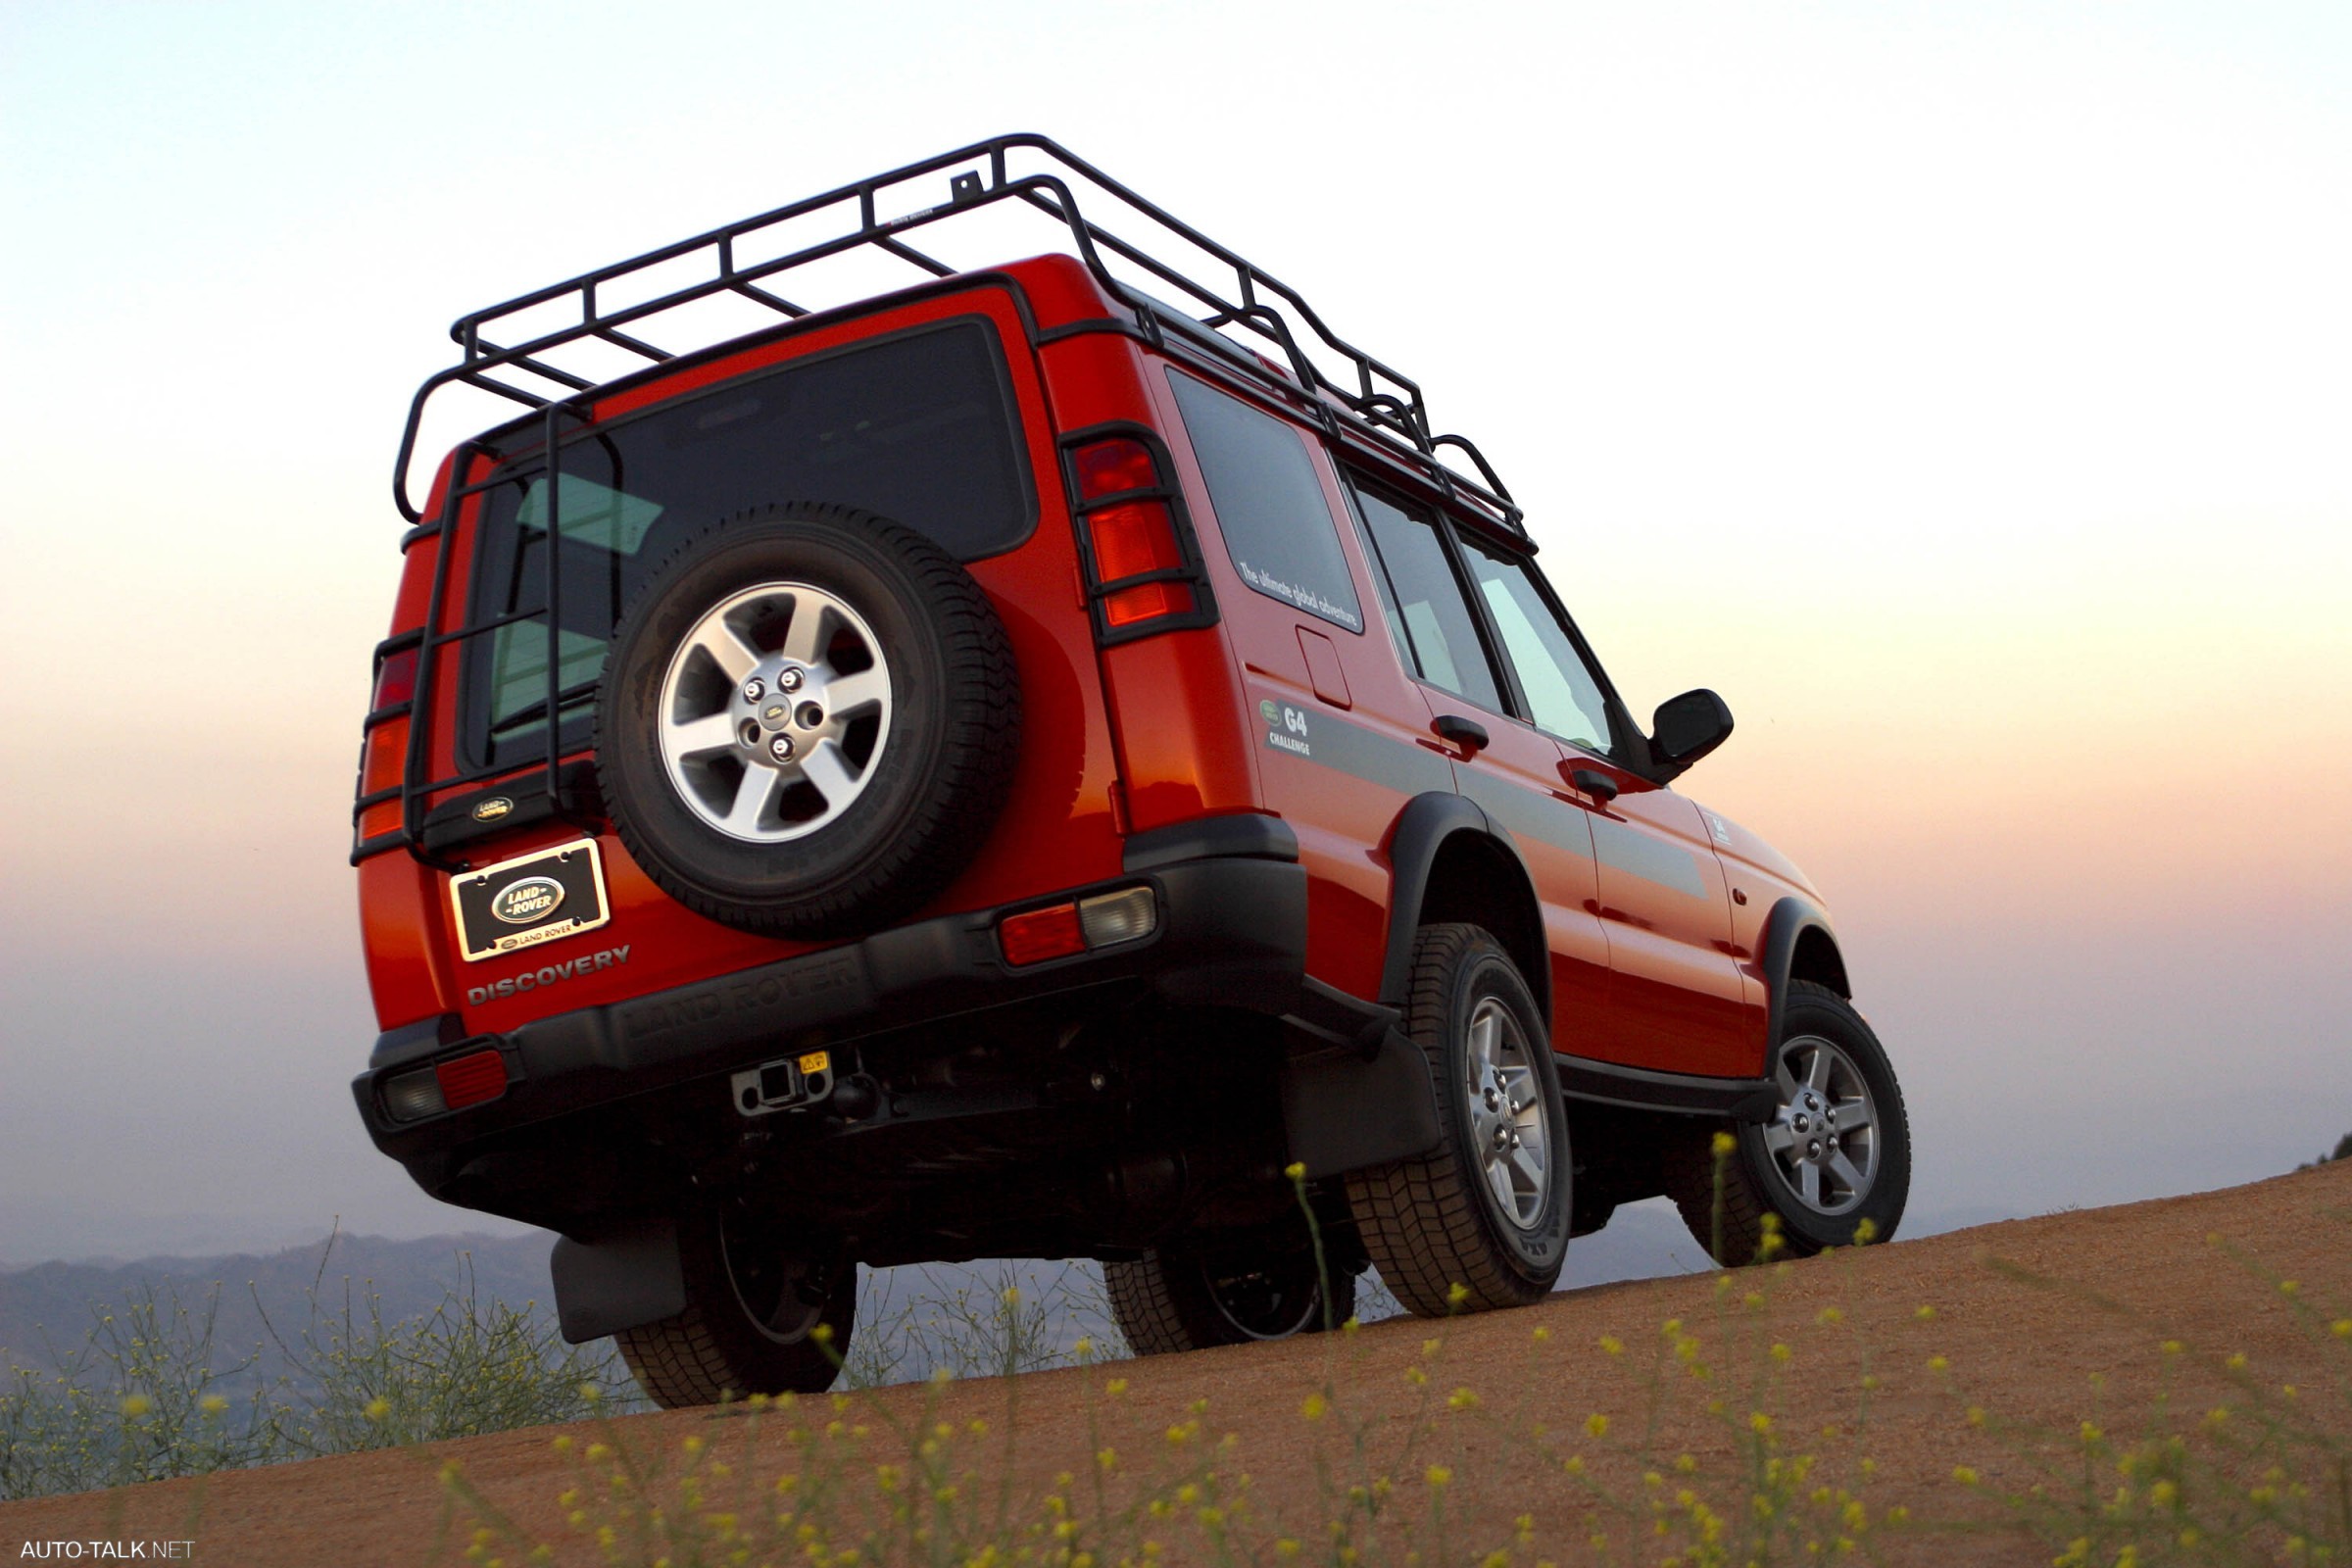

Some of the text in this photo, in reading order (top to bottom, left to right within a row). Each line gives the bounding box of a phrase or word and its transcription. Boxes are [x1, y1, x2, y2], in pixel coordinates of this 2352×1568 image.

[1240, 562, 1357, 626] The ultimate global adventure
[1269, 732, 1310, 756] CHALLENGE
[1285, 708, 1307, 737] G4
[519, 932, 542, 945] LAND
[544, 924, 571, 938] ROVER
[466, 945, 630, 1005] DISCOVERY
[623, 957, 858, 1041] LAND ROVER
